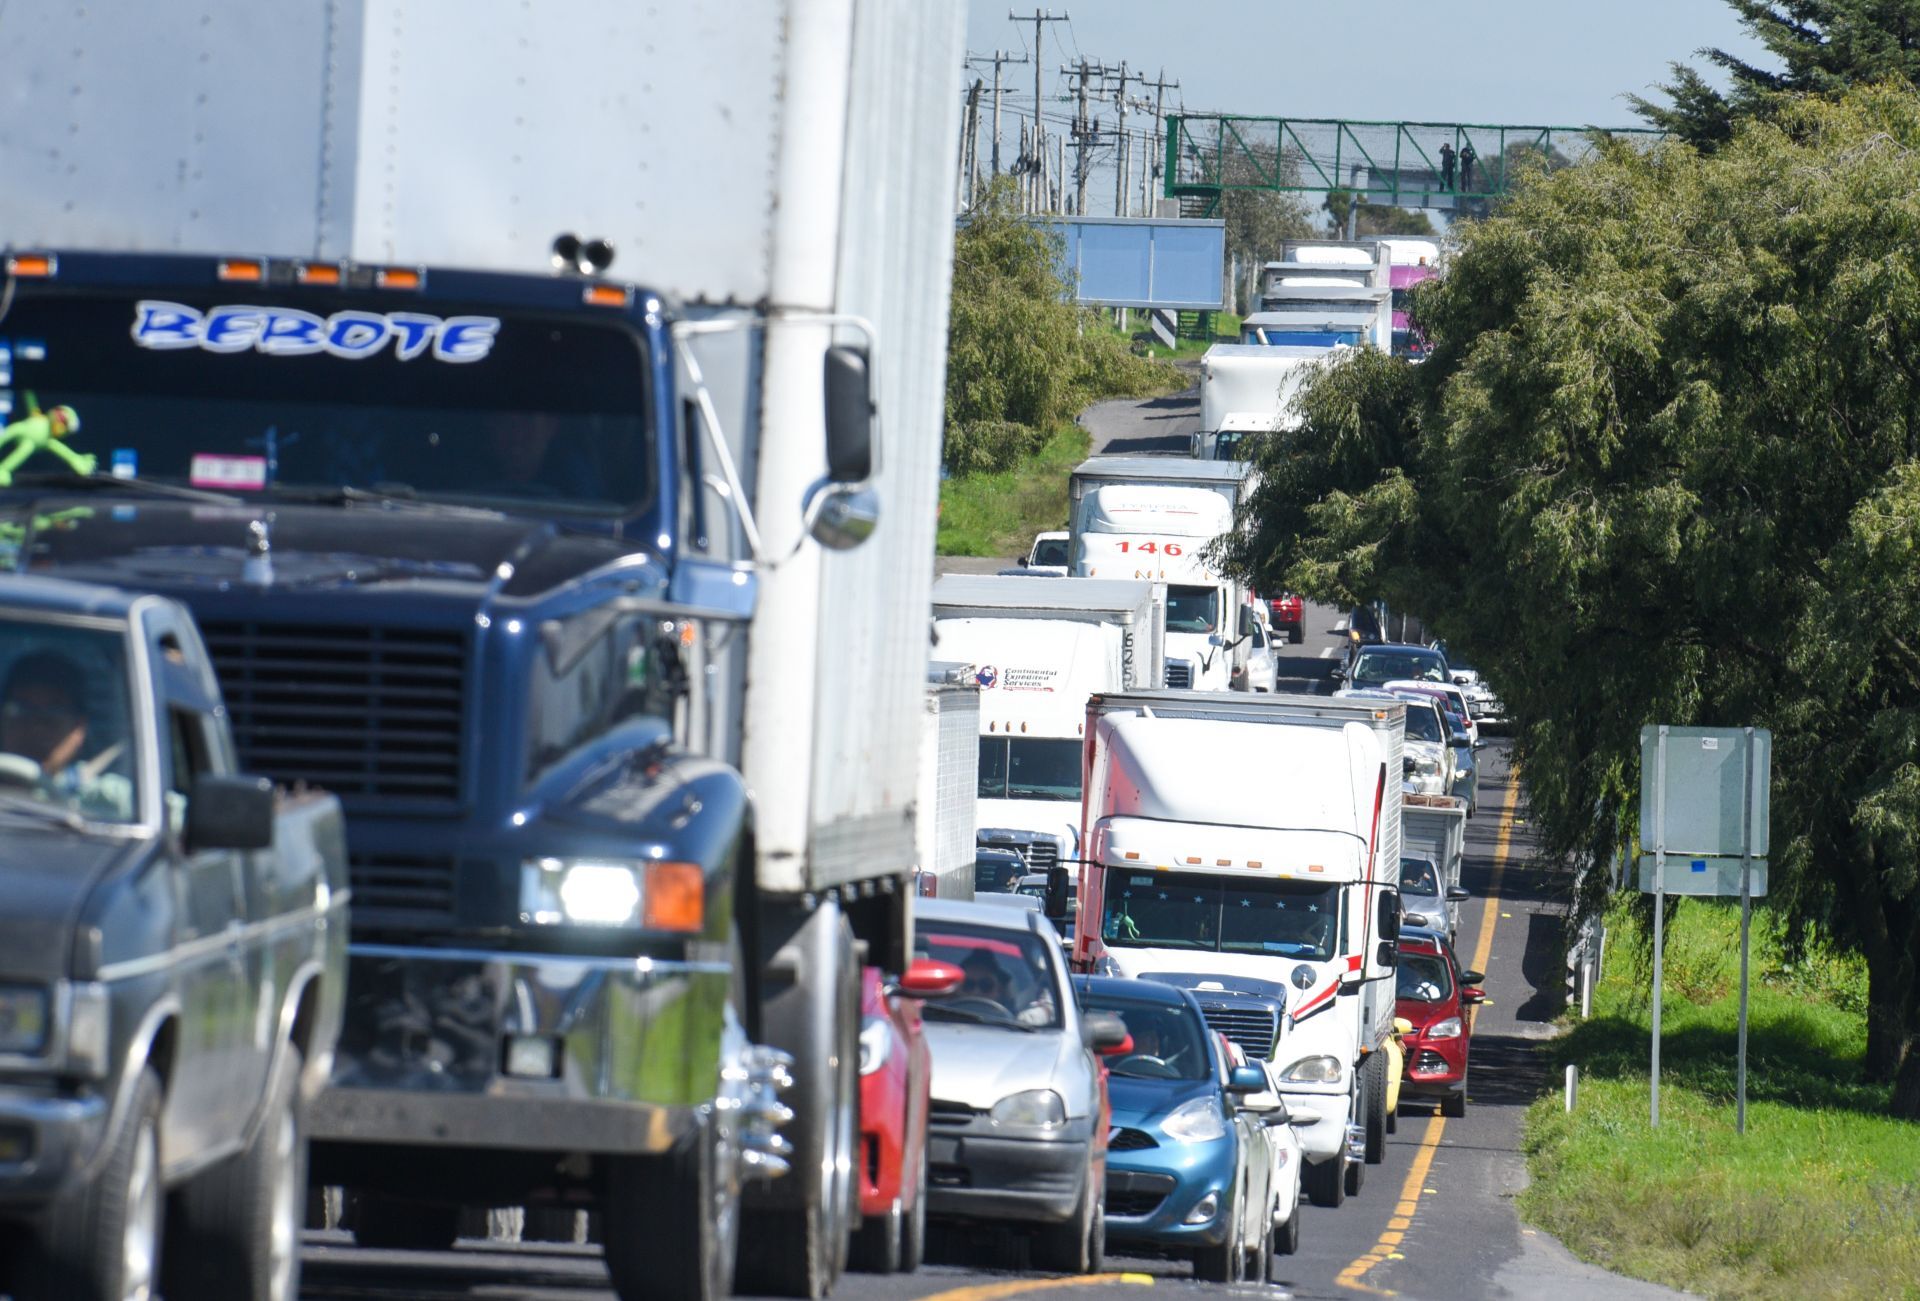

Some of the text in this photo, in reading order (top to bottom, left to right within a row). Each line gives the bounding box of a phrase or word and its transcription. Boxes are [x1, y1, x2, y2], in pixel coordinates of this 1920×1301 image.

[1115, 541, 1183, 556] 146
[1005, 668, 1058, 676] Continental
[1003, 679, 1042, 687] Services
